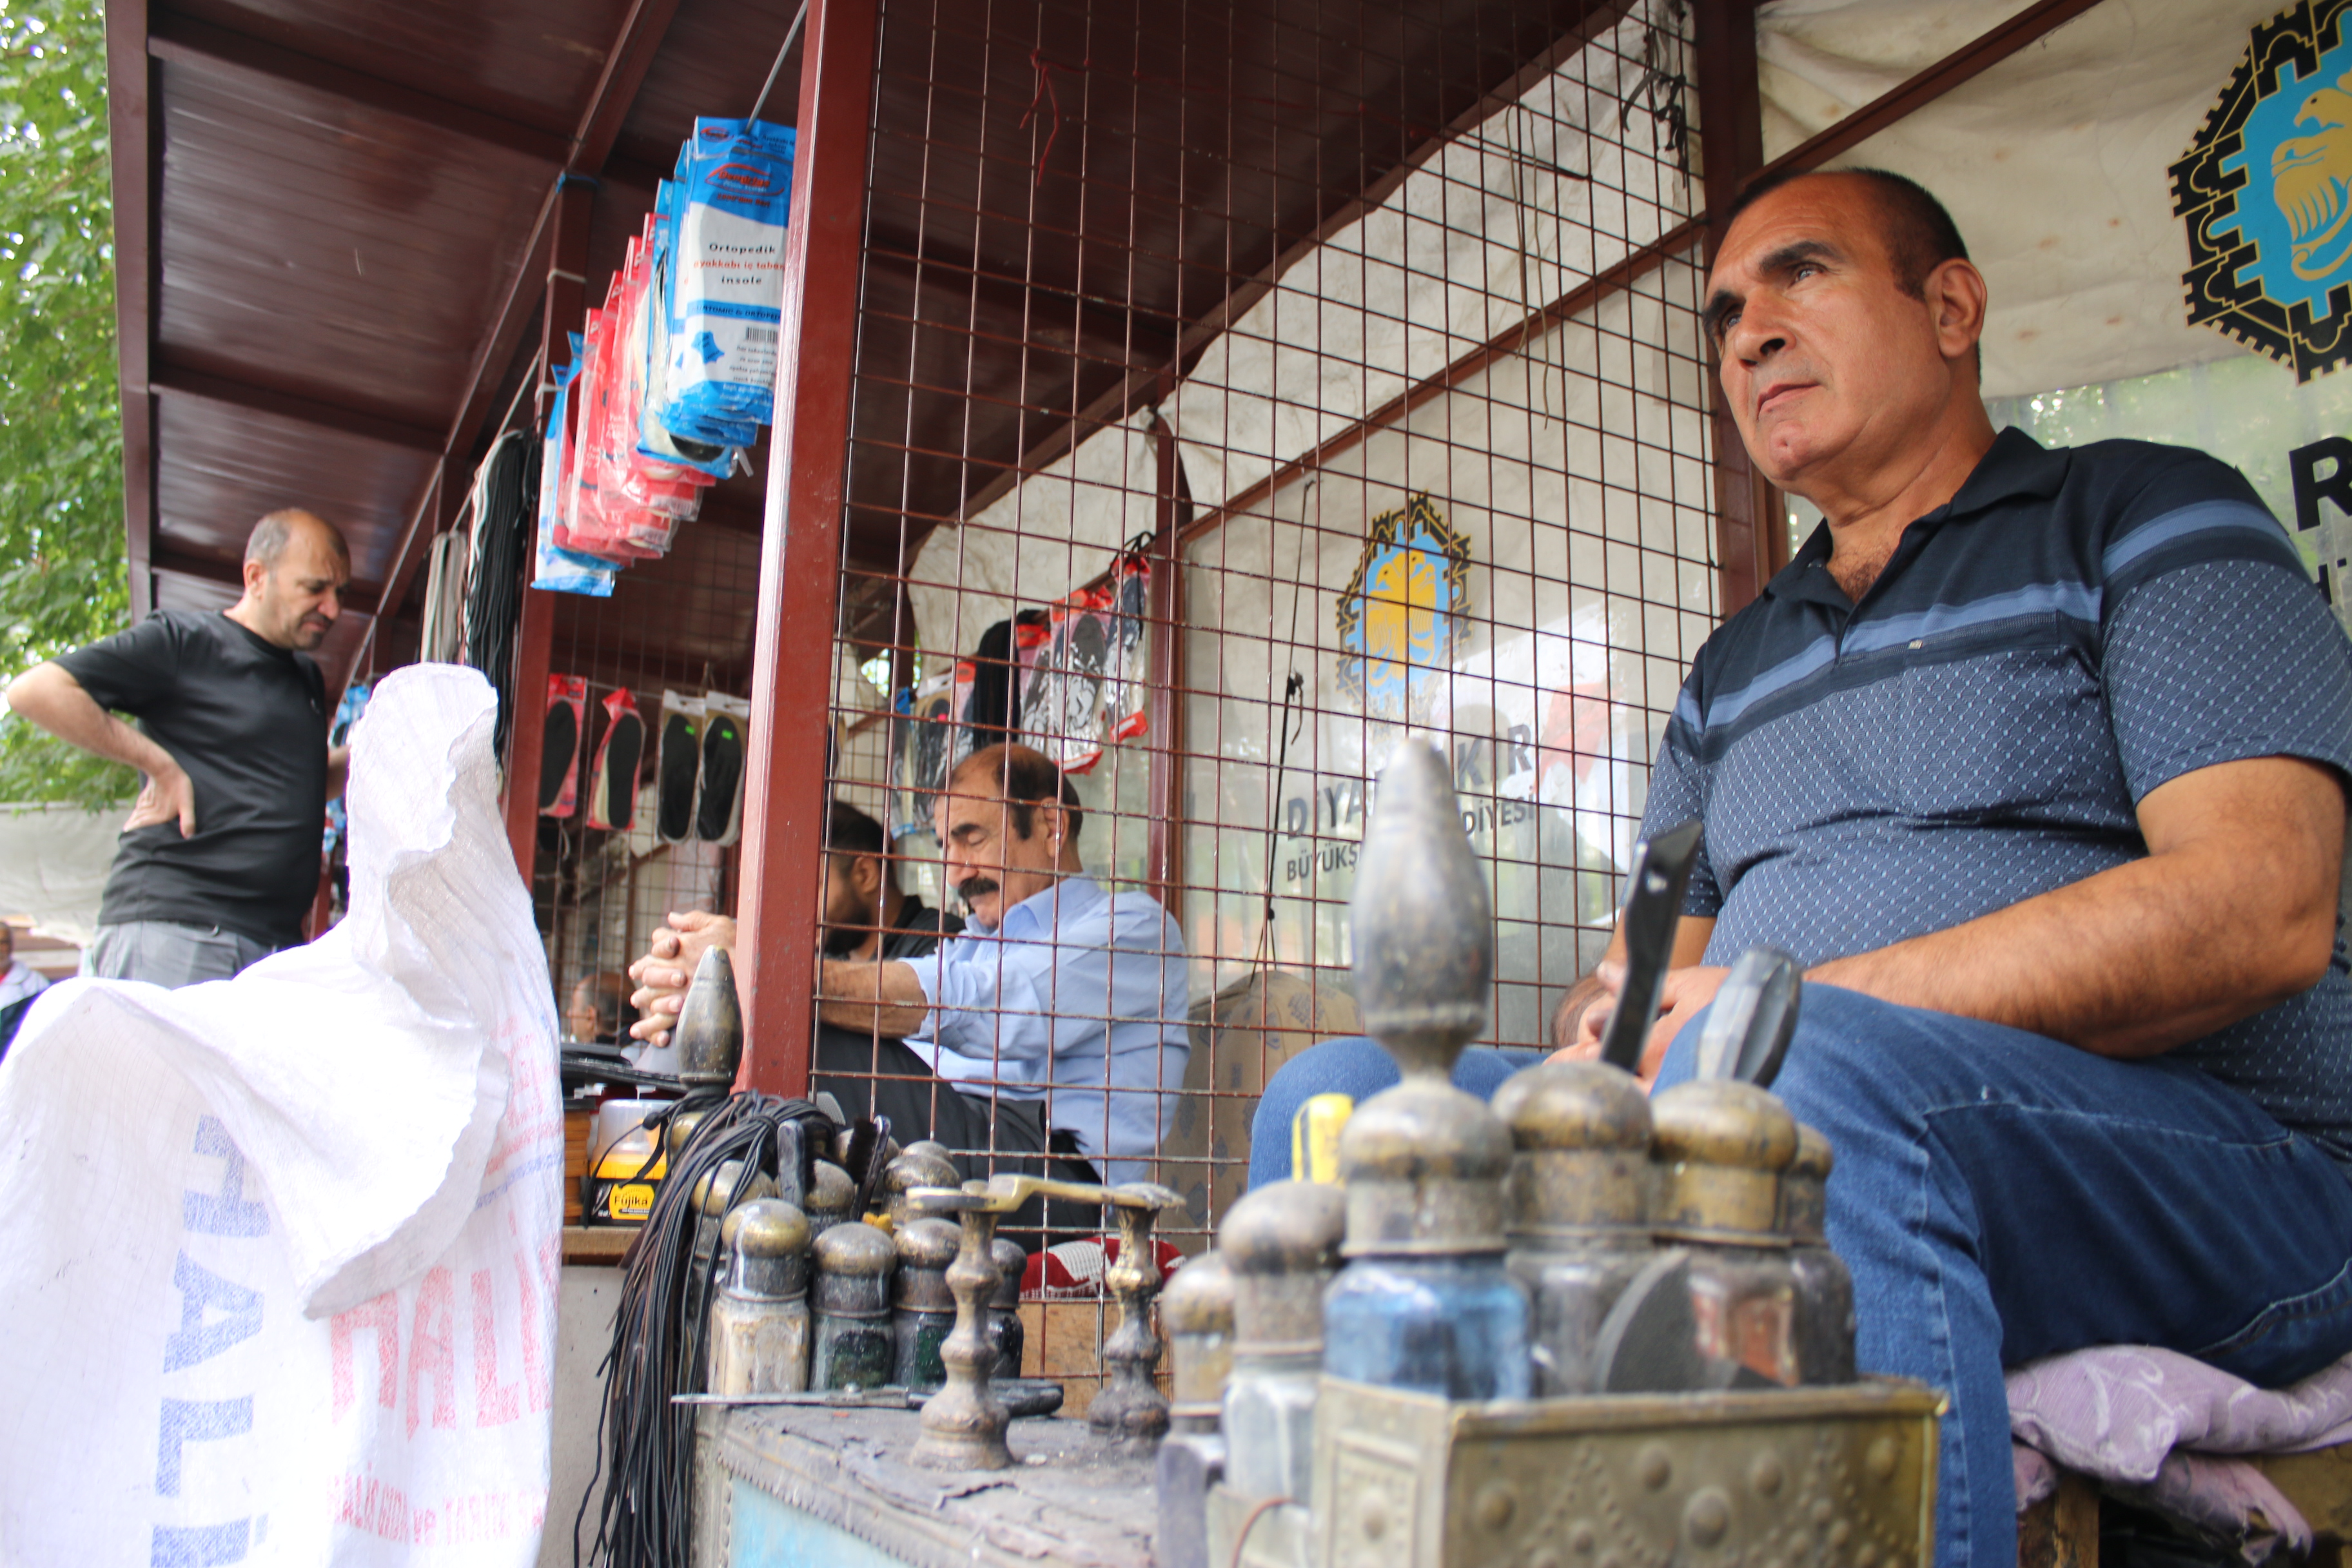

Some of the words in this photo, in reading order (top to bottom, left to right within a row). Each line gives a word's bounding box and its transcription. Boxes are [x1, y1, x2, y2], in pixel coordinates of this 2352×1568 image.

[709, 242, 776, 255] Ortopedik
[694, 259, 741, 270] ayakkabı
[744, 260, 753, 271] iç
[721, 275, 762, 285] insole
[614, 1195, 648, 1209] Fujika
[413, 1508, 436, 1547] ve
